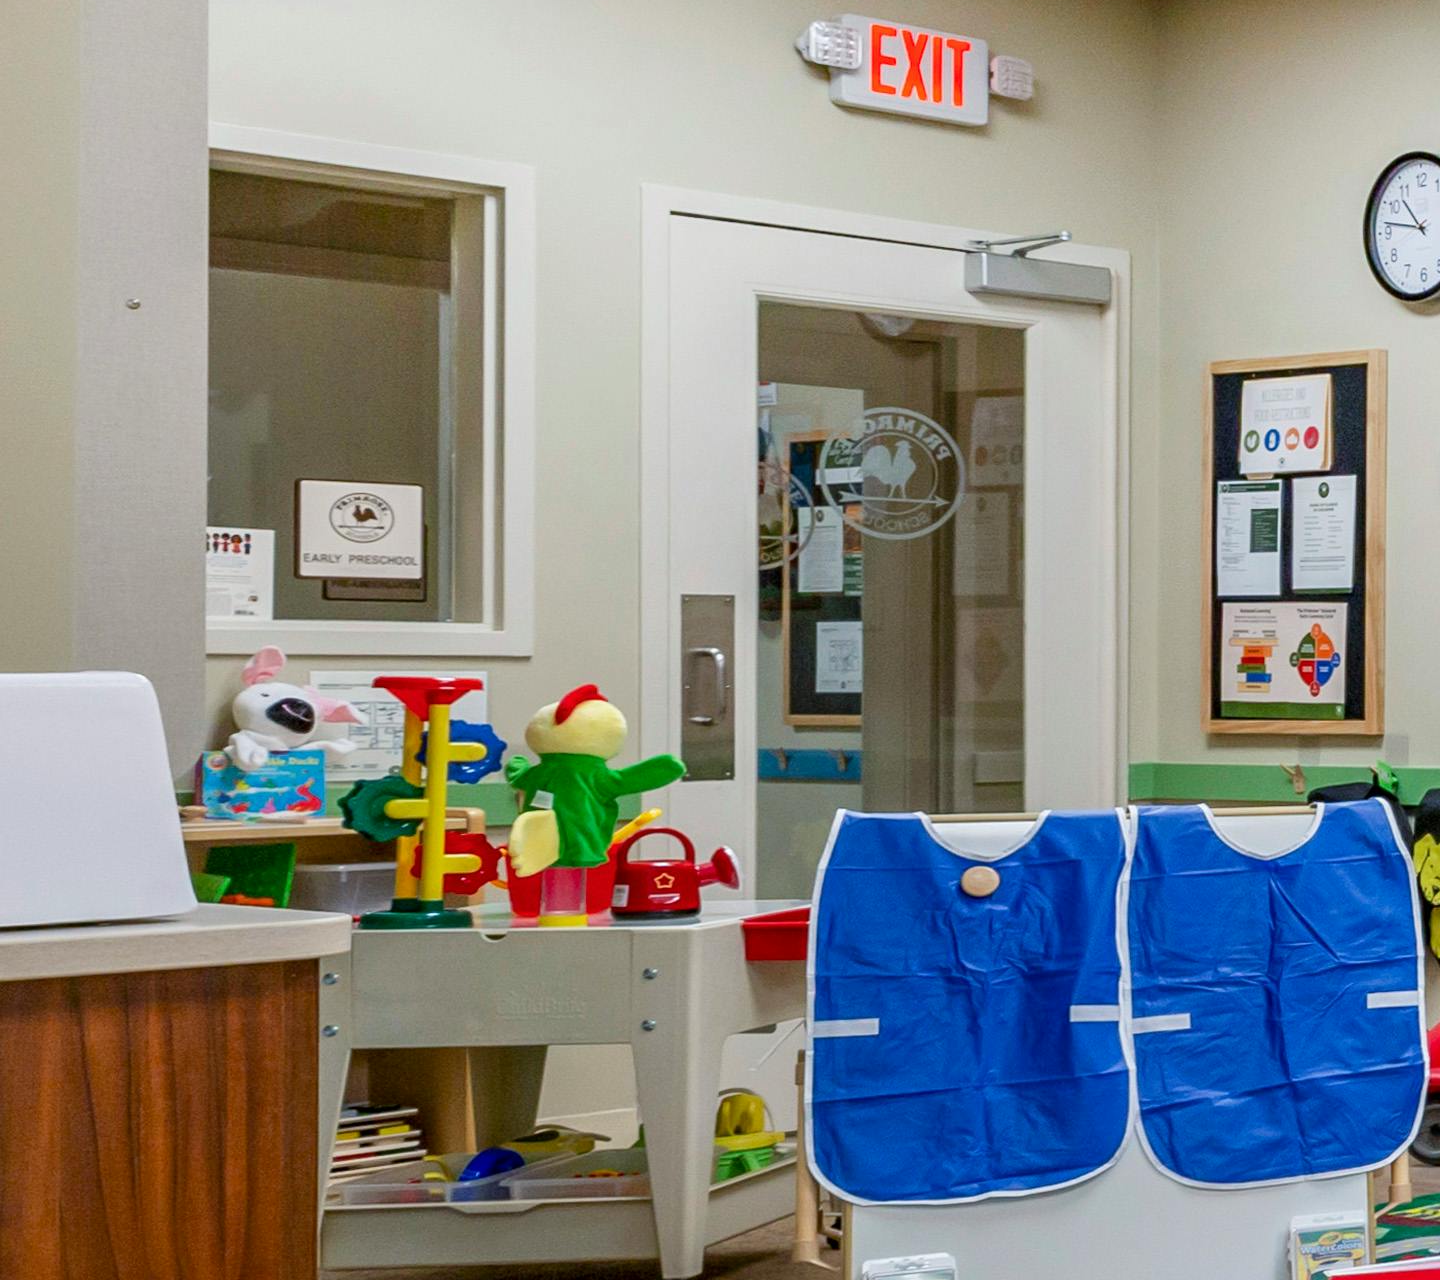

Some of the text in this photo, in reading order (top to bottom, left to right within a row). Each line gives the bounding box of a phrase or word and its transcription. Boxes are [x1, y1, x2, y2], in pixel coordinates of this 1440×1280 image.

[870, 24, 971, 108] EXIT
[1417, 173, 1428, 187] 12
[1435, 179, 1440, 192] 1
[1400, 184, 1410, 197] 11
[1390, 200, 1400, 214] 10
[1385, 225, 1392, 240] 9
[1390, 248, 1398, 262] 8
[1404, 264, 1411, 278] 7
[1420, 268, 1428, 282] 6
[303, 552, 419, 566] EARLY PRESCHOOL
